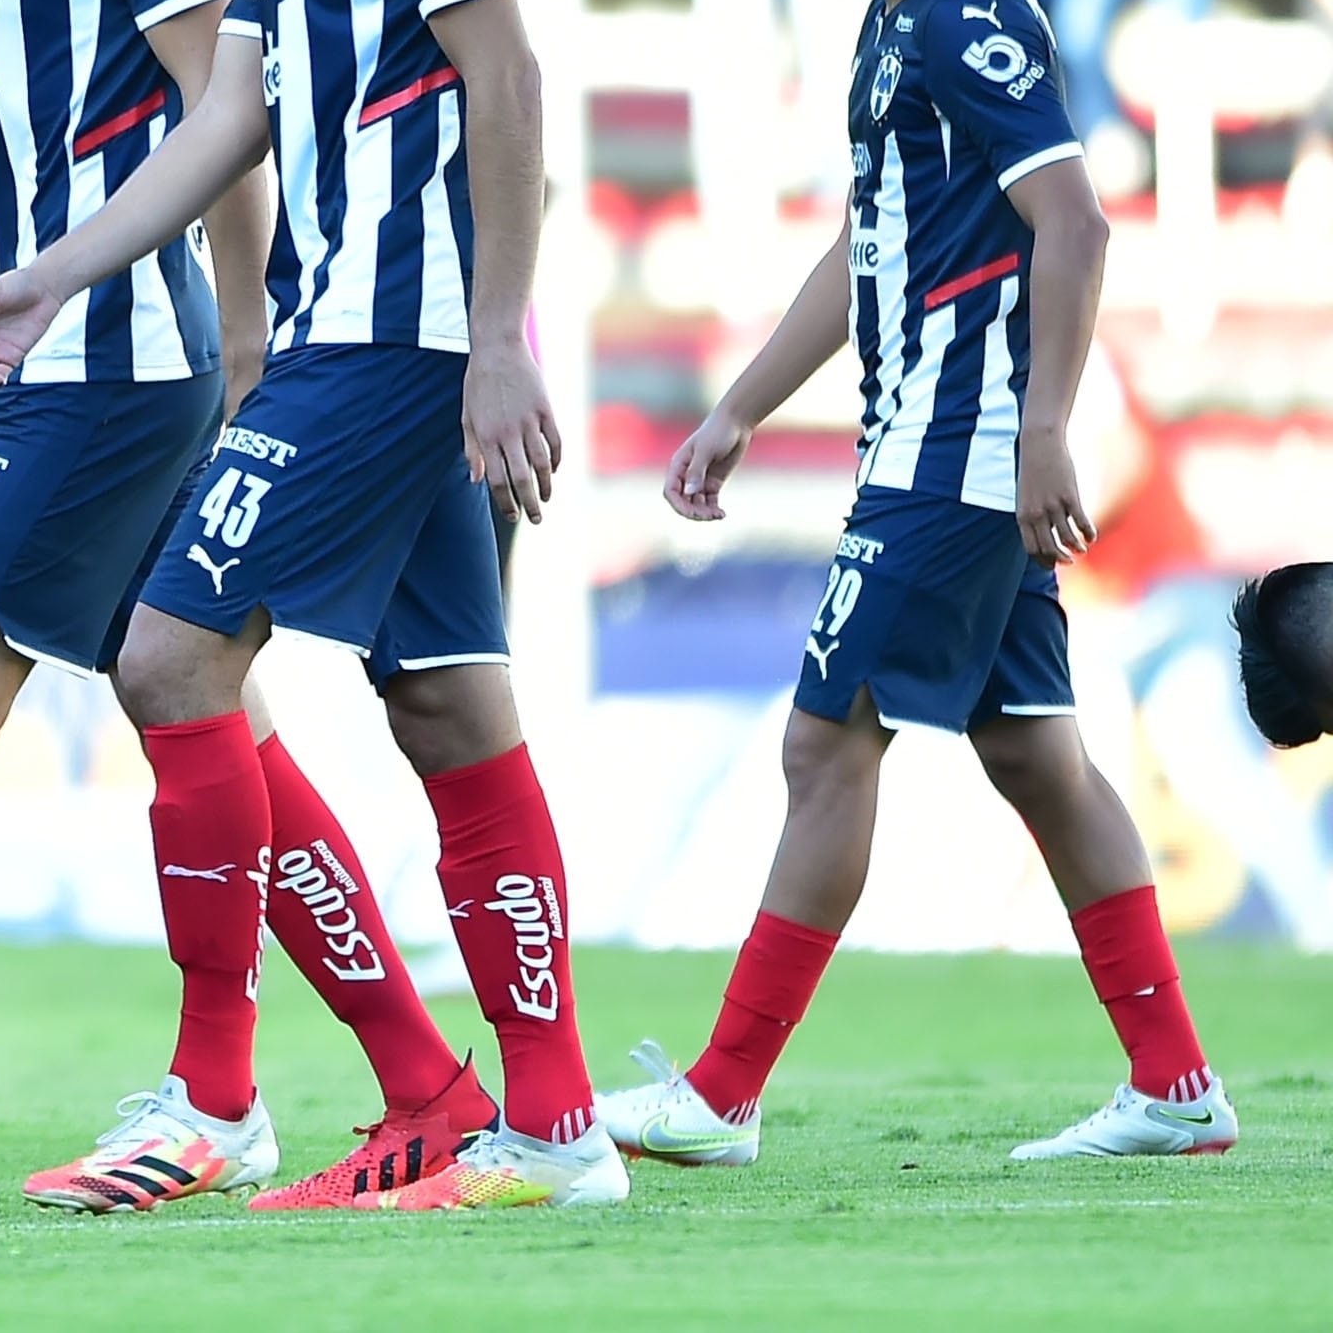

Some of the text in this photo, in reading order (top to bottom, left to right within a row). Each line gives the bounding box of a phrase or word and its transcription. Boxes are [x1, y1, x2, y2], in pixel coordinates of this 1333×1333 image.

[1006, 59, 1046, 101] Berel
[198, 466, 274, 548] 43
[811, 562, 863, 636] 29
[274, 849, 387, 981] Escudo
[483, 874, 559, 1022] Escudo
